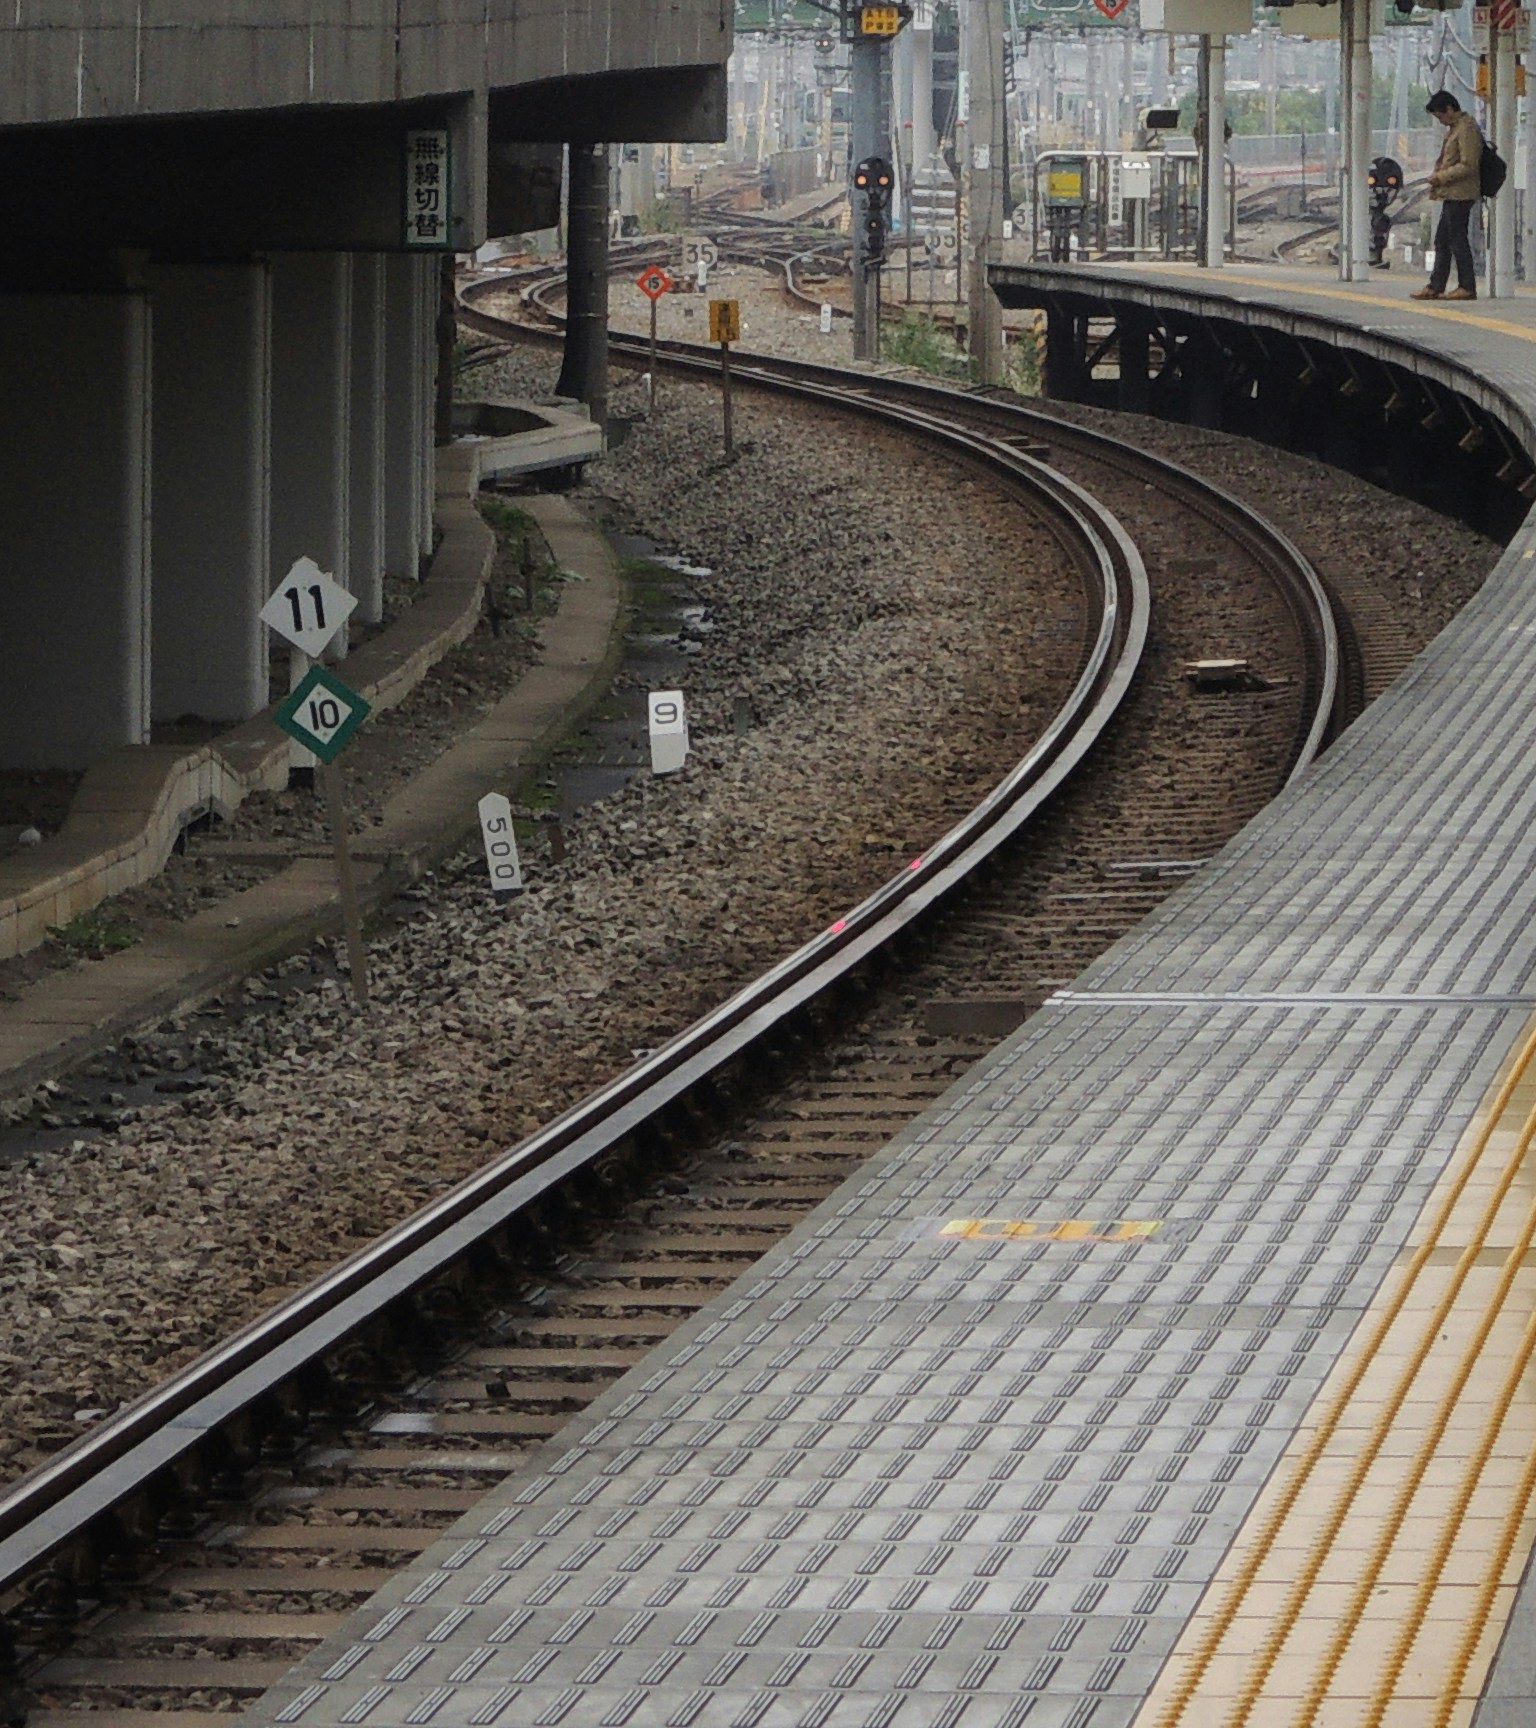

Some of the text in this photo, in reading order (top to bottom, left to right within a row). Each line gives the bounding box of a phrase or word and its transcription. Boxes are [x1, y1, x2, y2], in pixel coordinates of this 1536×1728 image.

[414, 135, 440, 238] 無線切替
[686, 243, 714, 264] 35
[648, 276, 660, 289] 15
[283, 584, 327, 633] 11
[308, 698, 341, 732] 10
[486, 816, 515, 879] 500
